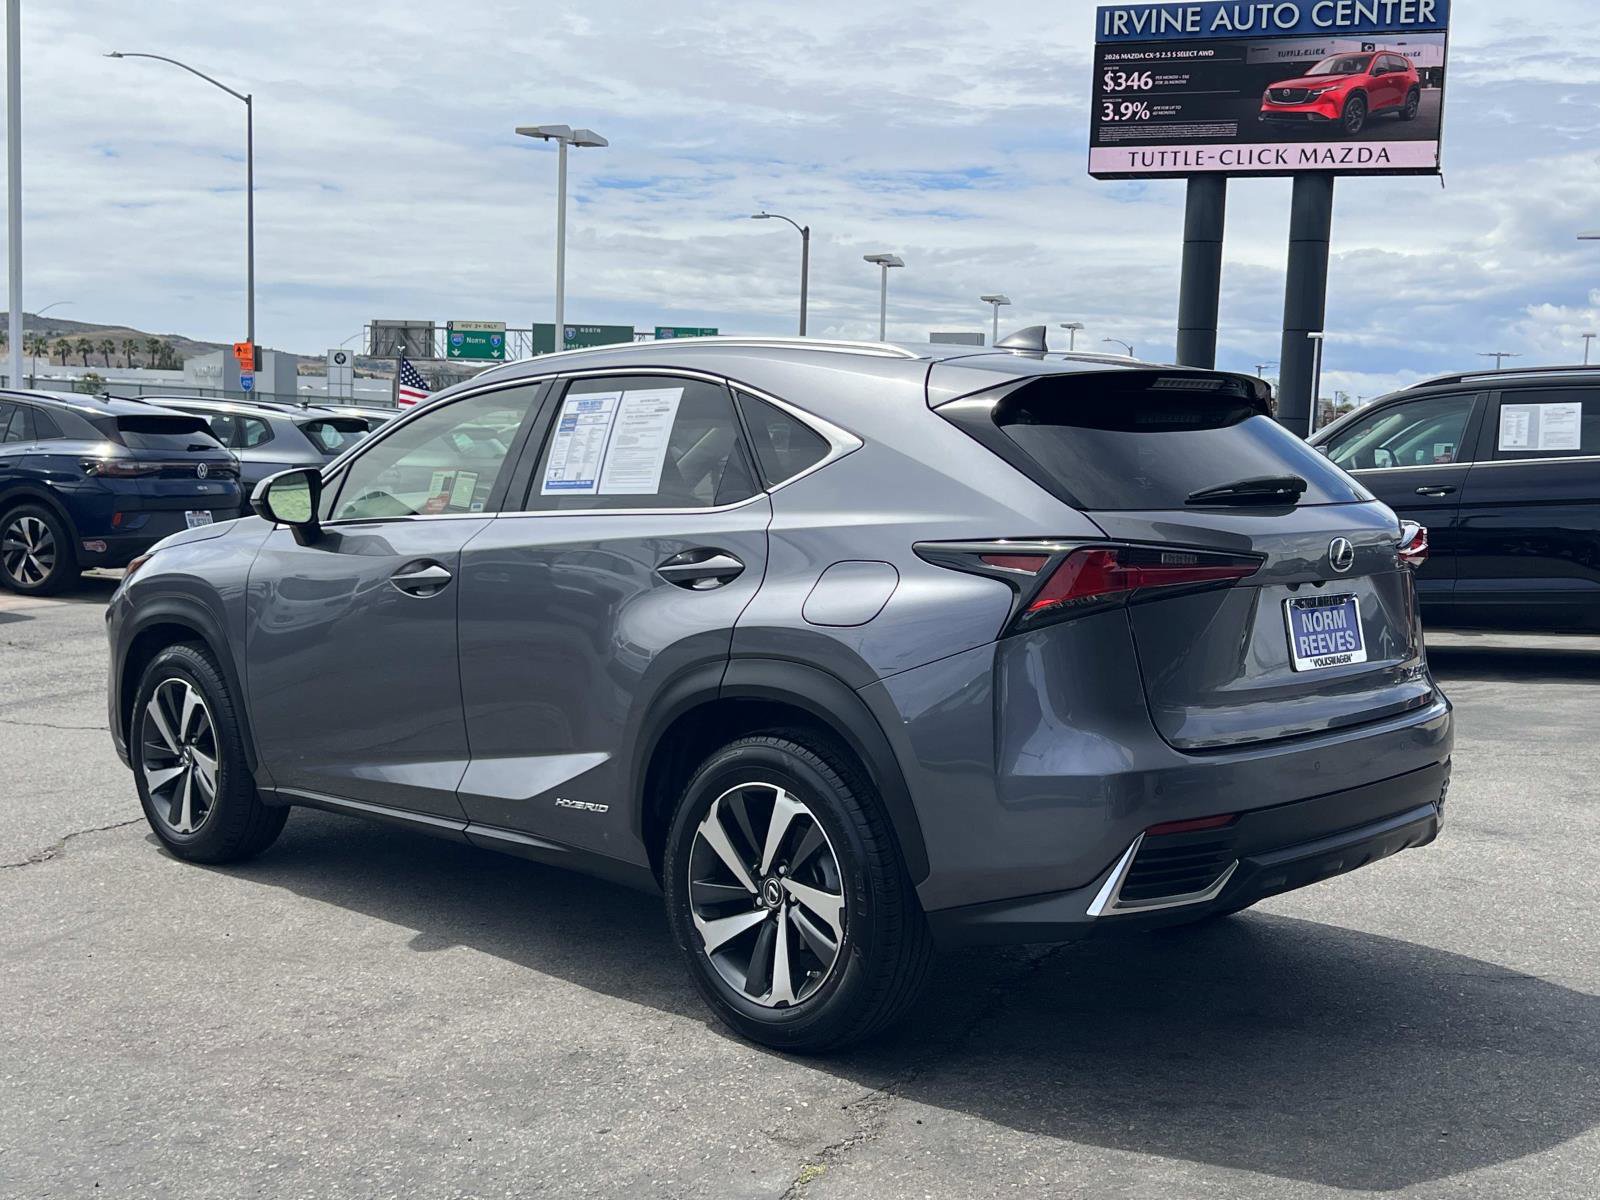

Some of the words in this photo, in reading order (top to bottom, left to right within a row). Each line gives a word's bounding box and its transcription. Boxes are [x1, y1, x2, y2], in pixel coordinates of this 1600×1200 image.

[1104, 7, 1201, 36] IRVINE
[1210, 2, 1300, 31] AUTO
[1311, 0, 1436, 27] CENTER
[1121, 52, 1144, 60] MAZDA
[1145, 51, 1160, 59] CX-5
[1177, 50, 1198, 58] SELECT
[1198, 49, 1215, 57] AWD
[1102, 70, 1153, 93] $346
[1101, 101, 1150, 121] 3.9%
[1128, 148, 1289, 167] TUTTLE-CLICK
[1299, 147, 1391, 164] MAZDA
[1301, 609, 1347, 633] NORM
[1300, 630, 1356, 656] REEVES
[1312, 654, 1353, 667] VOLKSWAGEN
[555, 798, 609, 813] HYBRID
